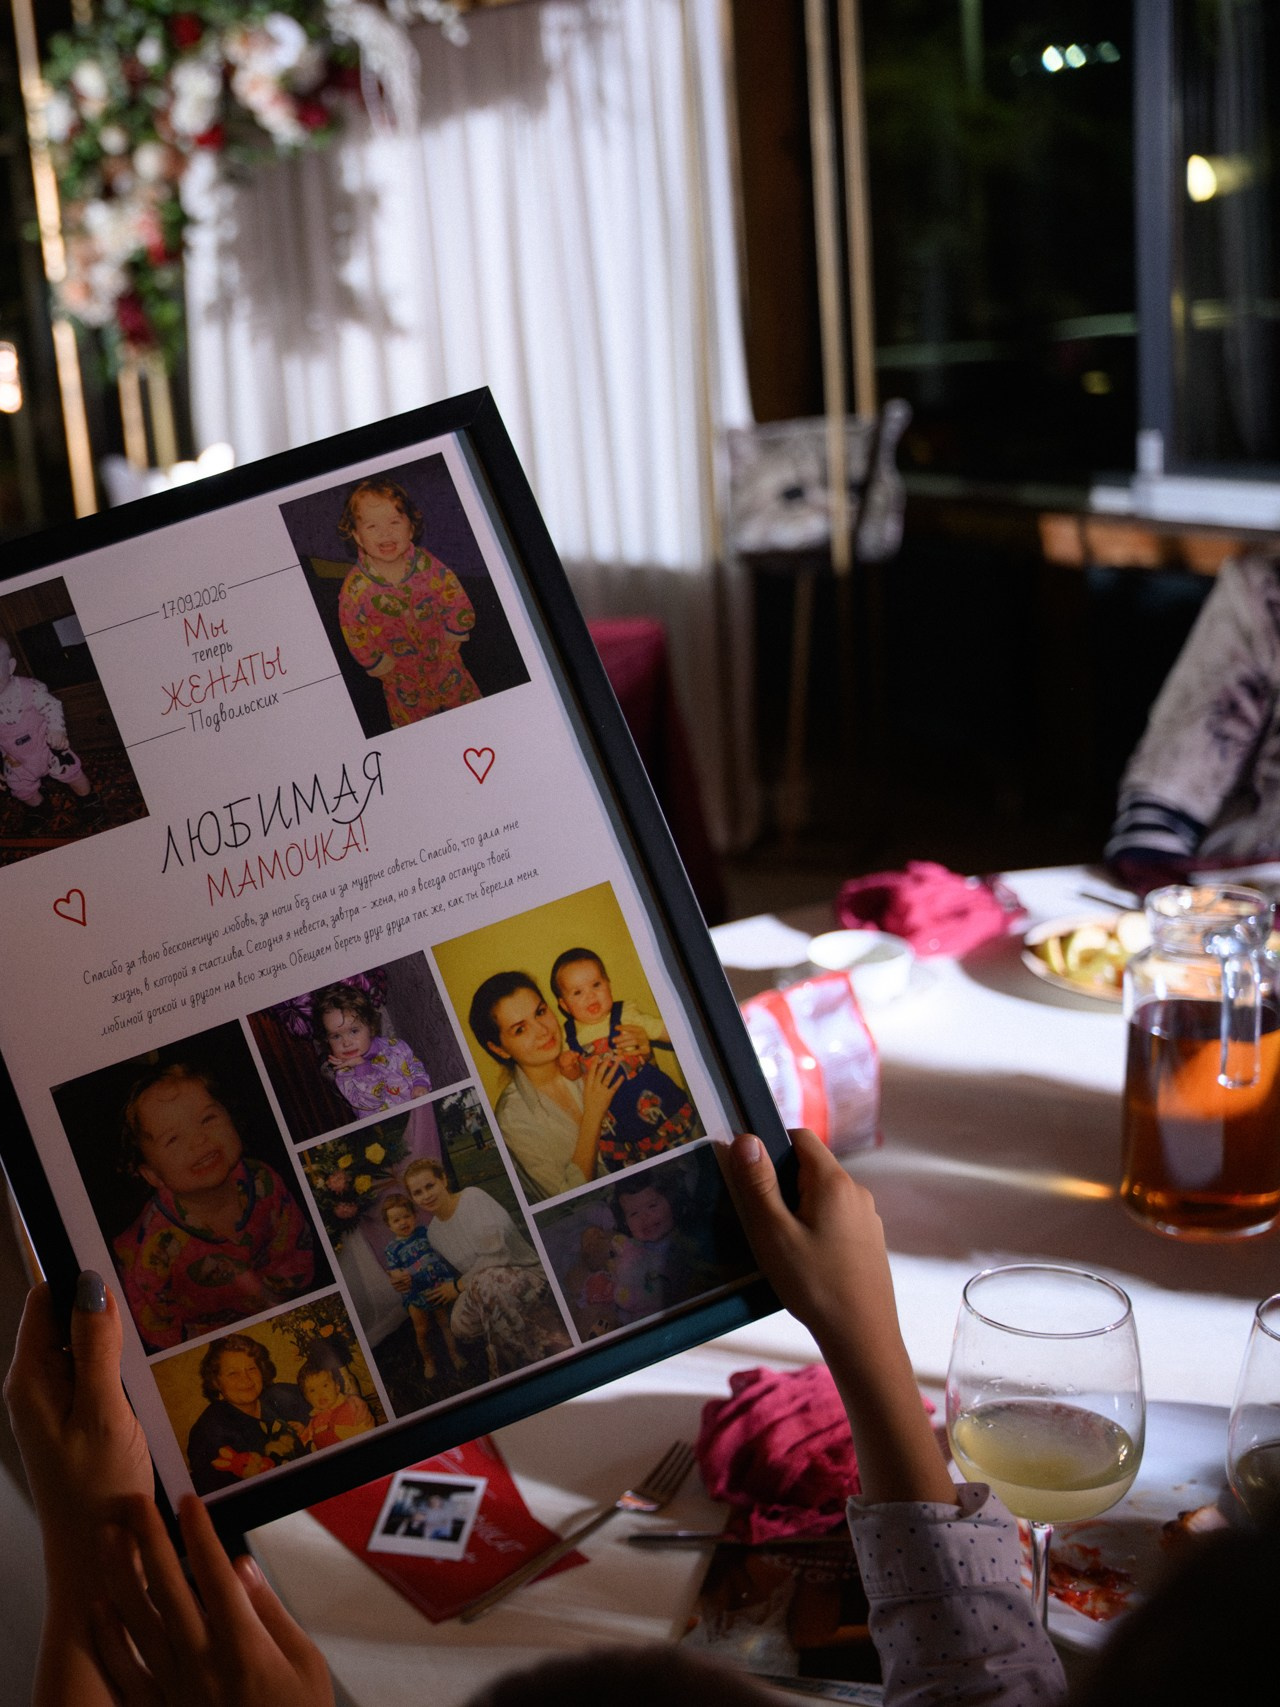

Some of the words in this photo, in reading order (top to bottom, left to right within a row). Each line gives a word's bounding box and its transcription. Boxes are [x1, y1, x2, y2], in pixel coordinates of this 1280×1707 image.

[161, 582, 228, 620] 17.09.2026
[183, 612, 229, 647] Мы
[160, 646, 288, 716] ЖЕНАТЫ
[191, 641, 233, 664] теперь
[187, 692, 280, 733] Подвольских
[161, 751, 384, 874] ЛЮБИМАЯ
[207, 815, 370, 907] МАМОЧКА!
[82, 959, 123, 985] Спасибо
[125, 960, 136, 976] за
[137, 949, 160, 965] твою
[161, 929, 219, 957] бесконечную
[222, 912, 258, 936] любовь,
[258, 911, 270, 927] за
[271, 903, 293, 917] ночи
[293, 893, 310, 911] без
[311, 890, 328, 903] сна
[329, 887, 336, 896] и
[338, 883, 349, 898] за
[351, 869, 385, 892] мудрые
[419, 838, 460, 863] Спасибо,
[460, 836, 475, 848] что
[477, 827, 500, 848] дала
[502, 820, 519, 832] мне
[111, 987, 143, 1004] жизнь,
[143, 976, 150, 992] в
[153, 965, 189, 988] которой
[191, 965, 197, 975] я
[246, 934, 284, 954] Сегодня
[285, 931, 291, 941] я
[293, 919, 328, 937] невеста,
[330, 906, 360, 929] завтра
[370, 894, 397, 910] жена,
[398, 888, 409, 899] но
[411, 885, 417, 895] я
[417, 874, 447, 892] всегда
[448, 861, 486, 881] останусь
[486, 848, 511, 865] твоей
[100, 1010, 144, 1037] любимой
[146, 998, 178, 1025] дочкой
[180, 998, 187, 1007] и
[189, 985, 221, 1009] другом
[223, 979, 236, 991] на
[237, 971, 256, 986] всю
[288, 944, 332, 967] Обещаем
[333, 934, 362, 952] беречь
[363, 925, 384, 945] друг
[386, 915, 411, 937] друга
[412, 908, 429, 921] так
[430, 903, 446, 915] же,
[447, 896, 465, 908] как
[465, 891, 479, 901] ты
[479, 877, 514, 896] берегла
